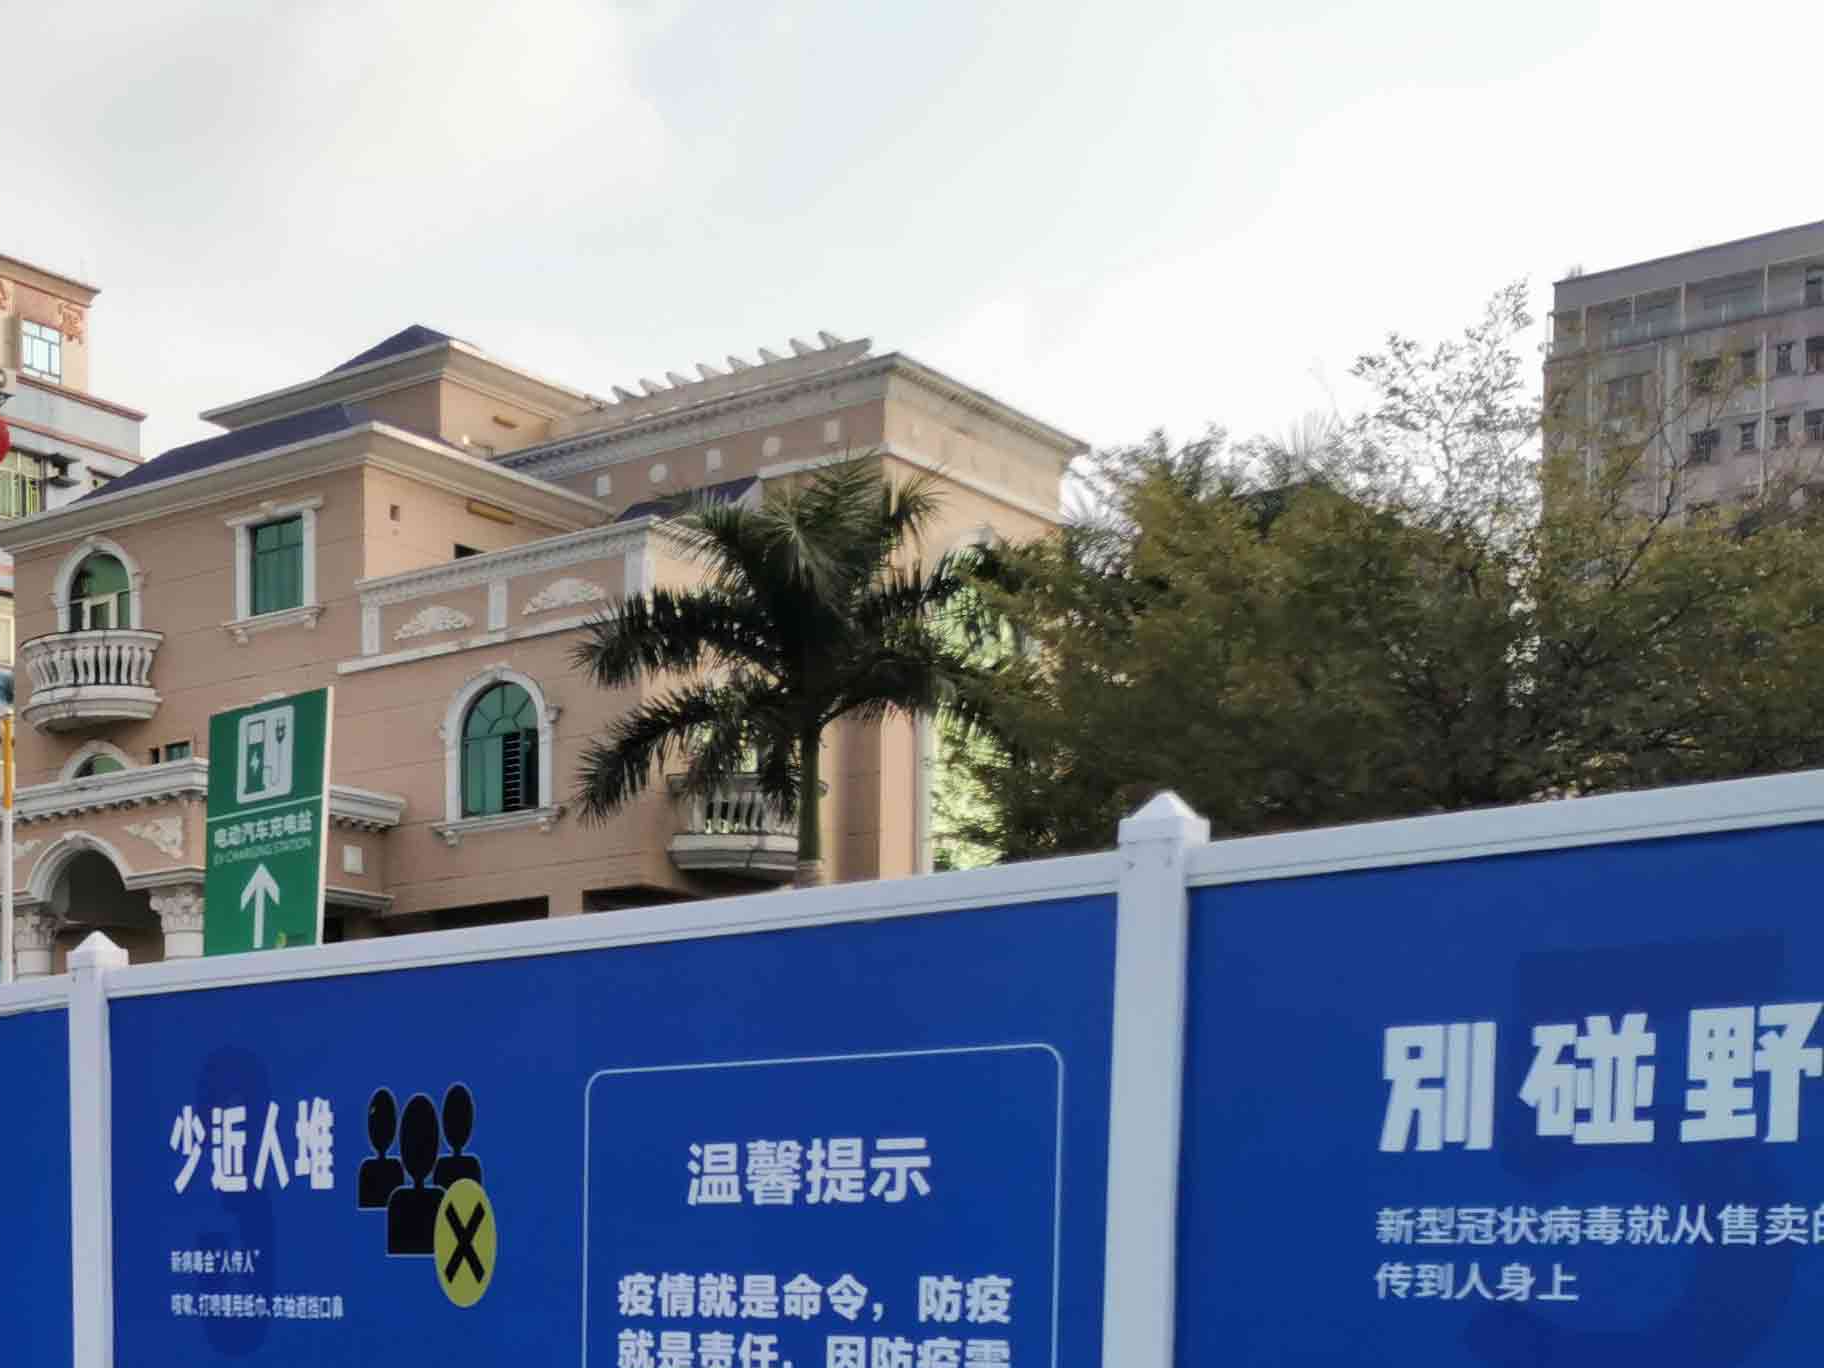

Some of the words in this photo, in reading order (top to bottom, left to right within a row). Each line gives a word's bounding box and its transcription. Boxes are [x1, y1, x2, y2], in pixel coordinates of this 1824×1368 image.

[213, 809, 313, 849] 电动汽车充电站
[1379, 1001, 1824, 1152] 别碰野
[169, 1096, 335, 1194] 少近人堆
[687, 1136, 931, 1206] 温馨提示
[617, 1272, 1013, 1324] 疫情就是命令，防疫
[1374, 1262, 1579, 1302] 传到人身上
